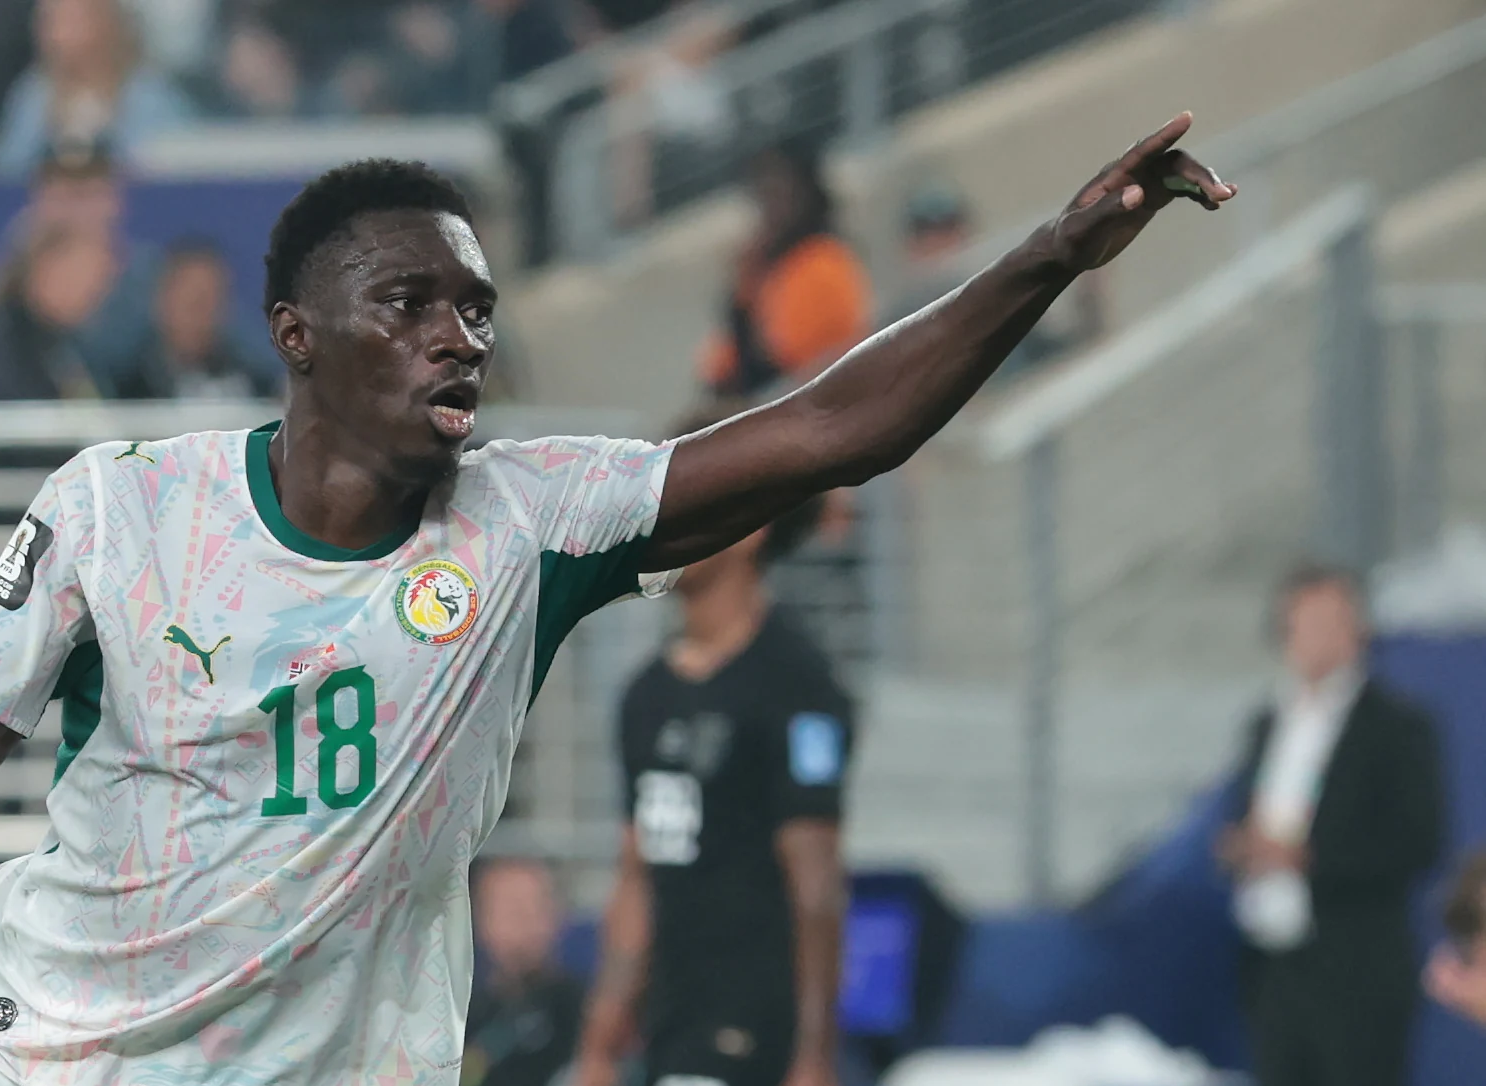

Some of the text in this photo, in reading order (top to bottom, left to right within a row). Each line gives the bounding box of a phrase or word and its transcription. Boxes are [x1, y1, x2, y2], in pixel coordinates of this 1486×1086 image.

[0, 563, 13, 574] FIFA
[438, 611, 475, 641] FOOTBALL
[258, 664, 377, 816] 18
